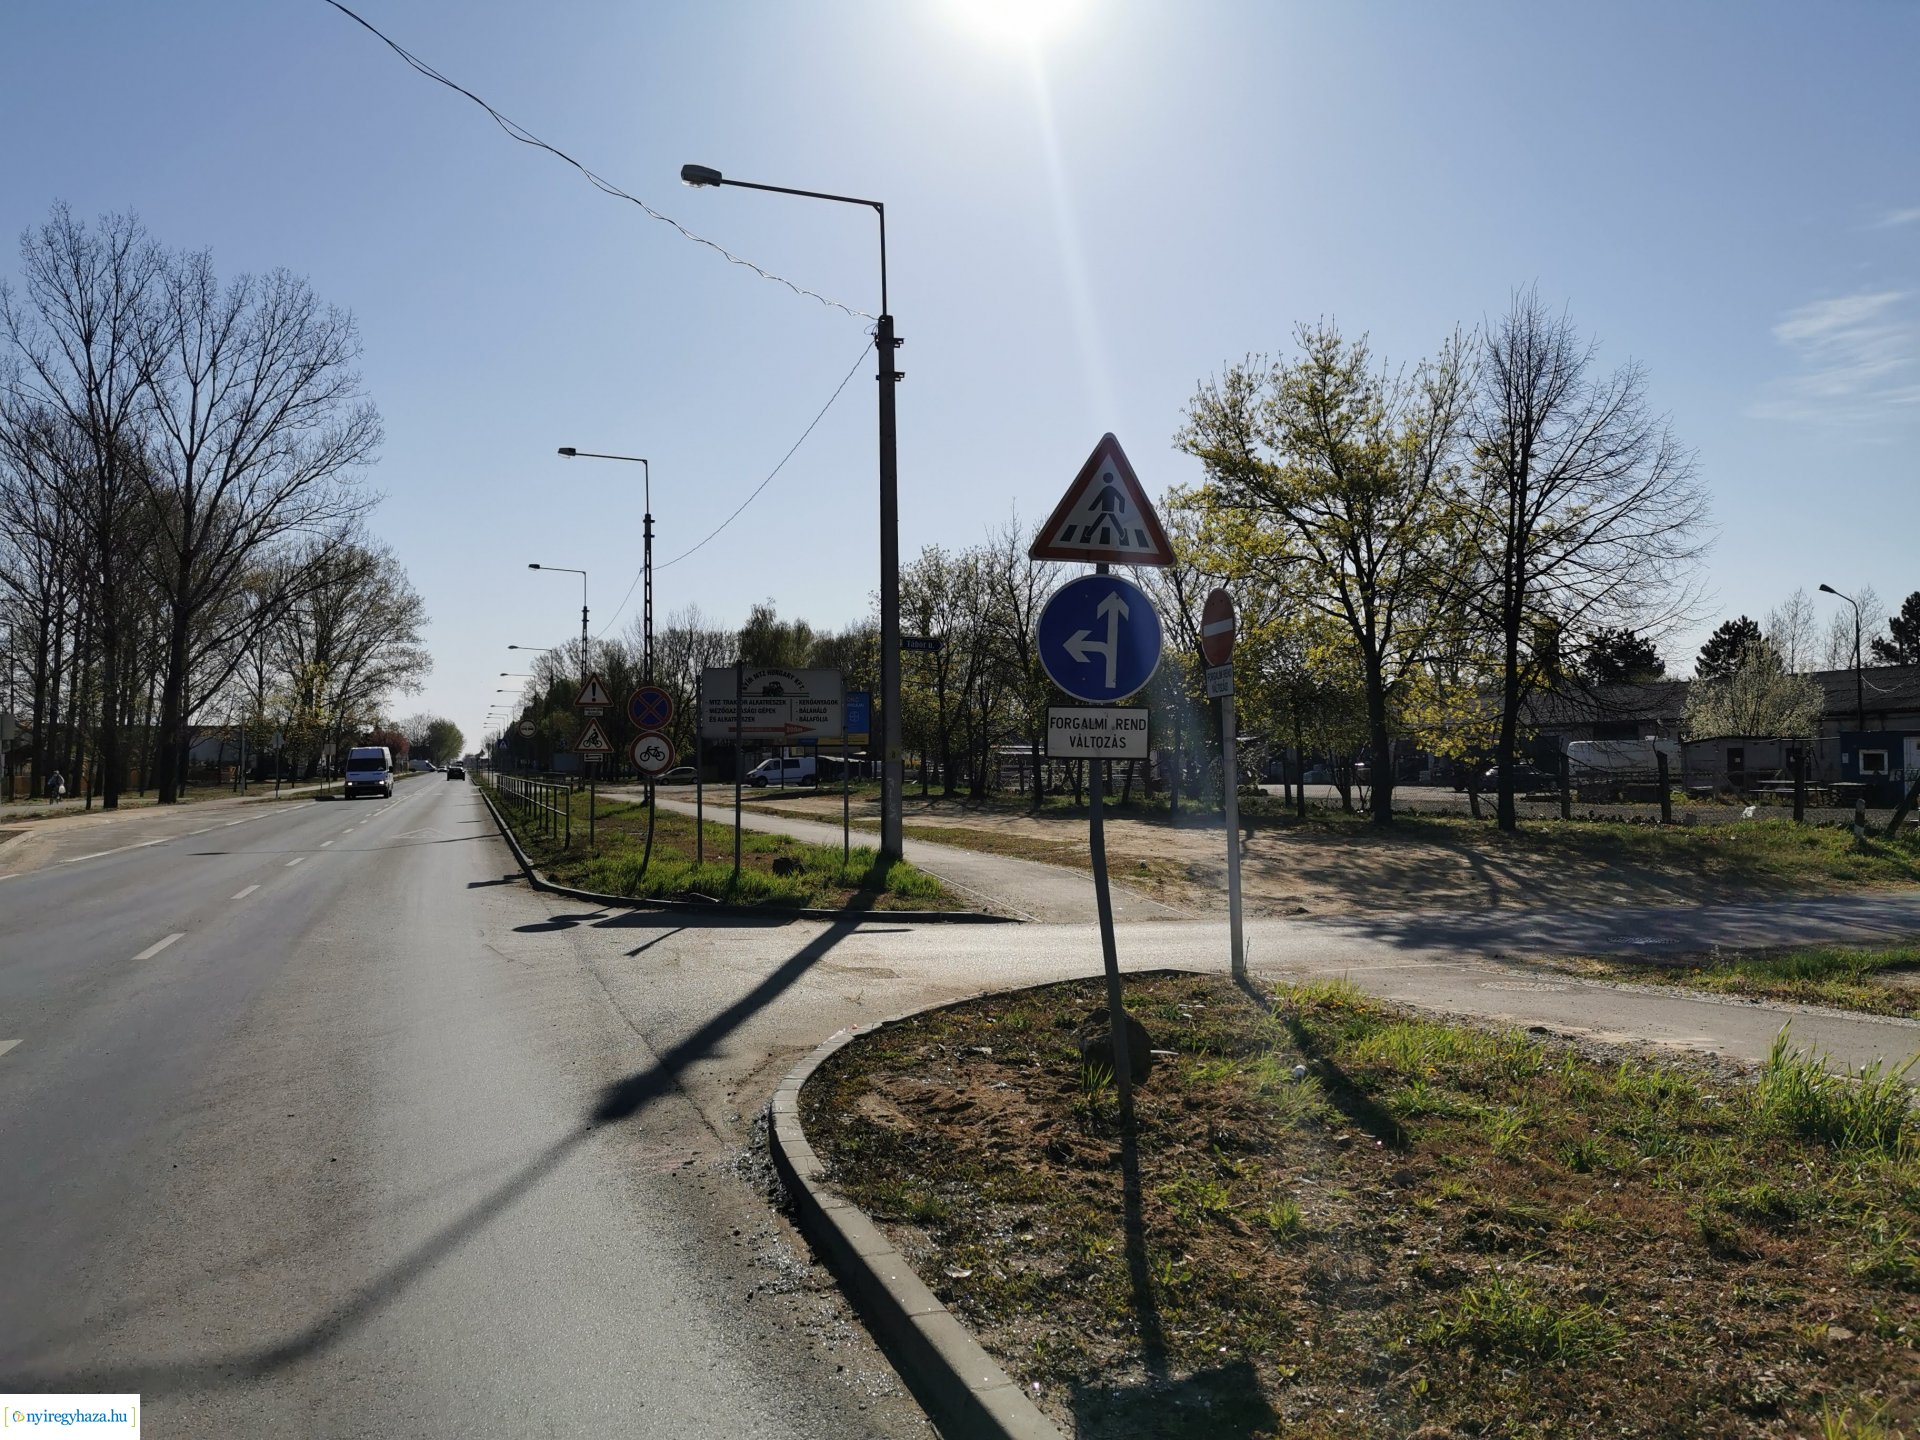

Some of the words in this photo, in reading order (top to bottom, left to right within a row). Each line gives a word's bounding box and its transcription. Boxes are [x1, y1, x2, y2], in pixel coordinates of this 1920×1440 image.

[767, 669, 795, 680] HUNGARY
[757, 706, 777, 714] GÉPEK
[1049, 717, 1108, 731] FORGALMI
[1115, 717, 1147, 731] REND
[1069, 733, 1127, 749] VÁLTOZÁS
